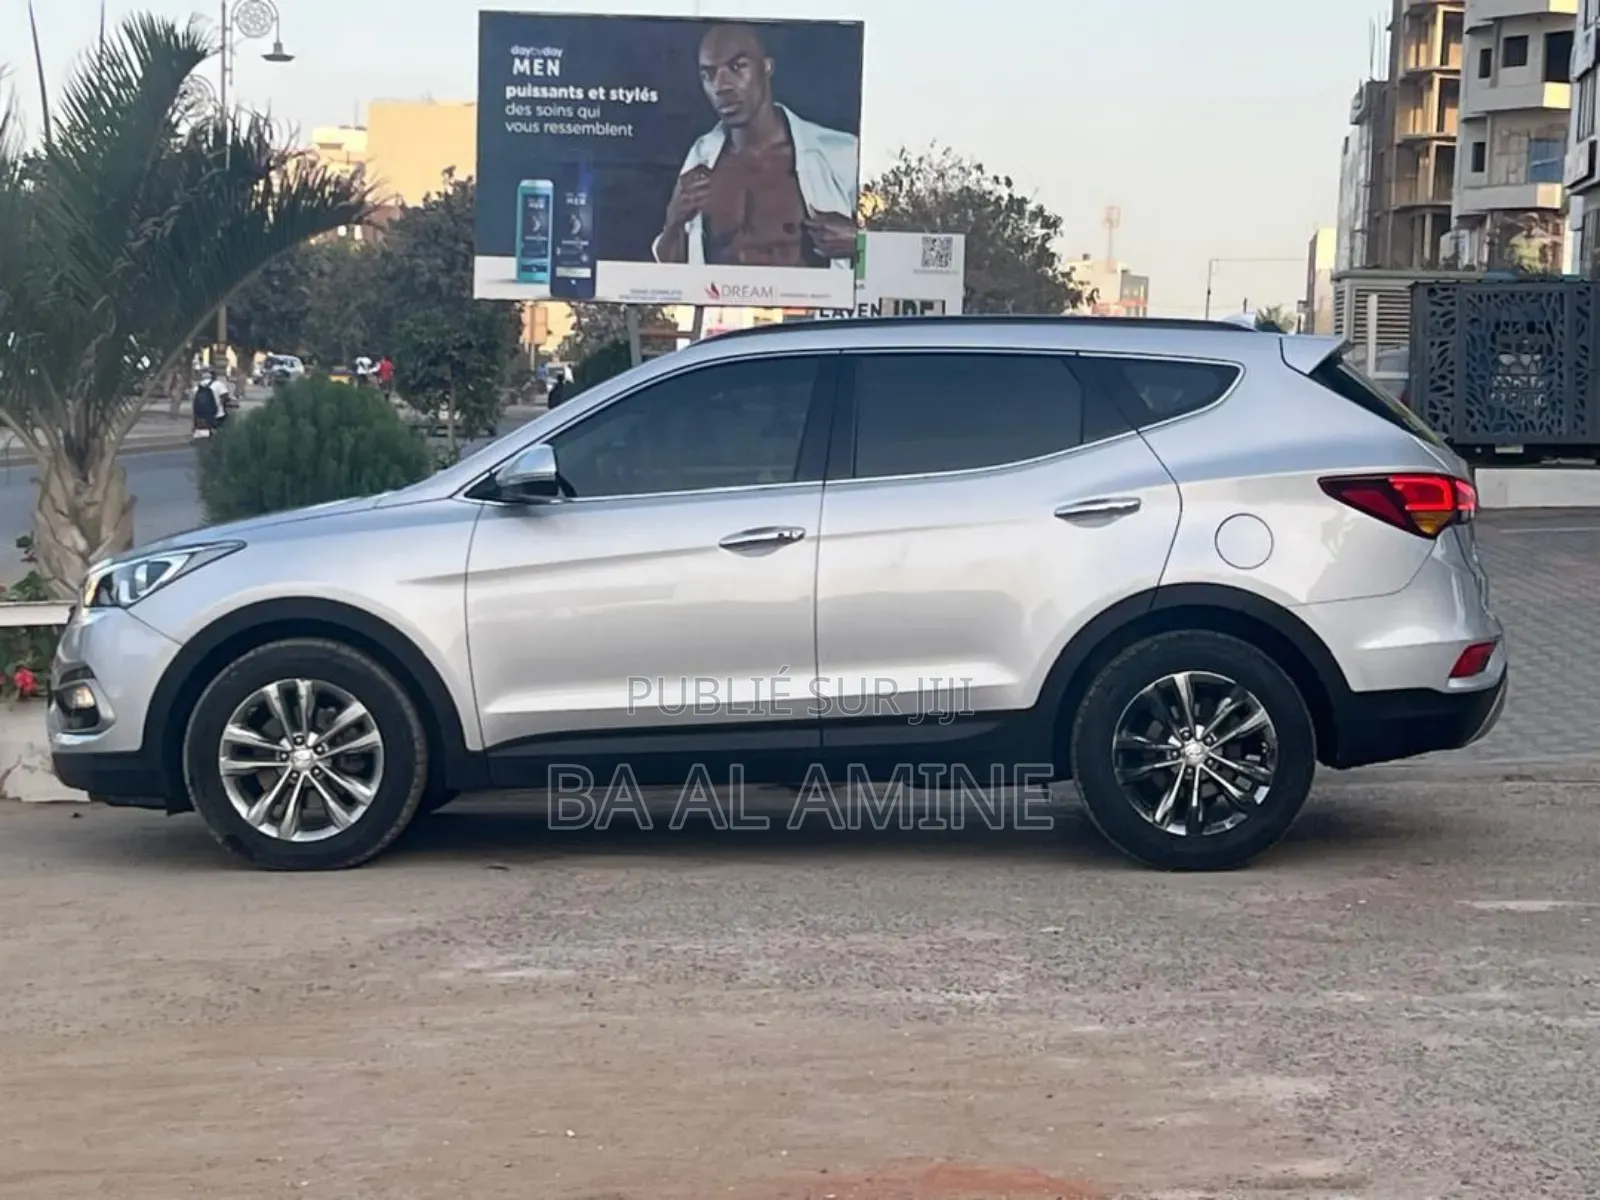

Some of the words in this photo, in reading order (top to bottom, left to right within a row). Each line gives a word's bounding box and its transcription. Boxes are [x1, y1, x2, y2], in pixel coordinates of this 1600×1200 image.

[512, 57, 560, 77] MEN
[505, 83, 584, 99] puissants
[588, 86, 606, 100] et
[609, 86, 659, 104] stylés
[505, 102, 532, 117] des
[536, 104, 574, 118] soins
[577, 104, 601, 120] qui
[505, 121, 540, 133] vous
[543, 121, 634, 137] ressemblent
[721, 284, 774, 298] DREAM
